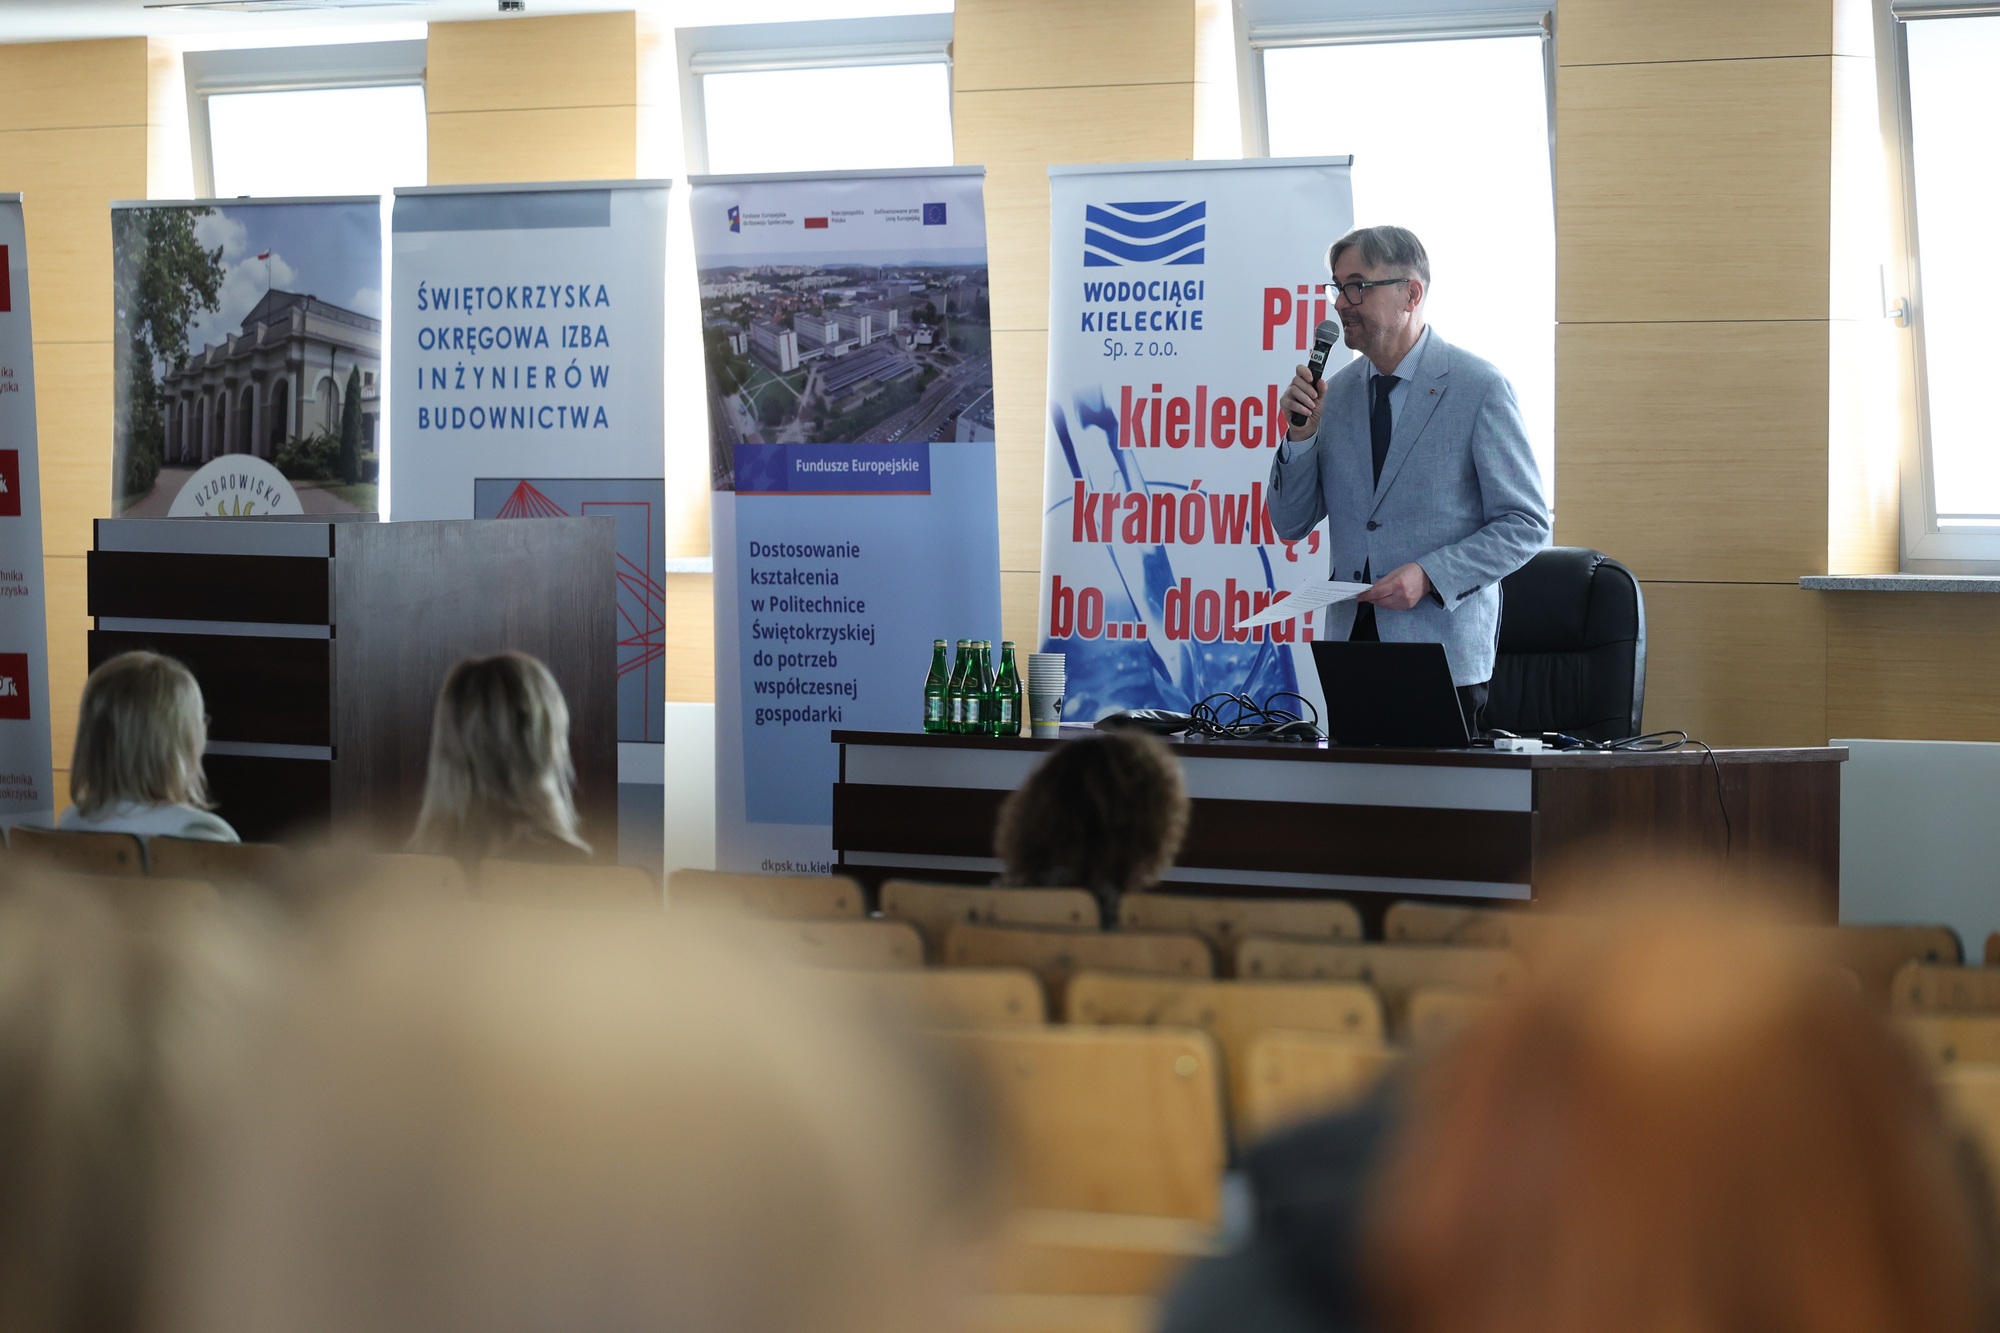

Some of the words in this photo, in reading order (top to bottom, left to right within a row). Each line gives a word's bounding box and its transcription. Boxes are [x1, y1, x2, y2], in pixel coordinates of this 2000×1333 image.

[417, 281, 610, 316] ŚWIĘTOKRZYSKA
[1083, 280, 1204, 307] WODOCIĄGI
[1081, 310, 1203, 332] KIELECKIE
[418, 326, 549, 355] OKRĘGOWA
[562, 325, 610, 348] IZBA
[1103, 338, 1128, 361] Sp.
[1134, 342, 1143, 356] z
[1148, 341, 1178, 356] o.o.
[418, 358, 610, 390] INŻYNIERÓW
[418, 405, 609, 430] BUDOWNICTWA
[1119, 383, 1288, 449] kieleck
[796, 458, 849, 472] Fundusze
[852, 458, 919, 475] Europejskie
[195, 473, 282, 507] UZDROWISKO
[1072, 479, 1320, 563] kranówk,
[750, 541, 860, 558] Dostosowanie
[751, 568, 839, 585] kształcenia
[751, 599, 765, 612] w
[770, 595, 865, 613] Politechnice
[1050, 575, 1147, 640] bo...
[752, 619, 875, 646] Świętokrzyskiej
[753, 650, 773, 667] do
[778, 650, 838, 671] potrzeb
[754, 677, 857, 700] współczesnej
[755, 705, 842, 726] gospodarki
